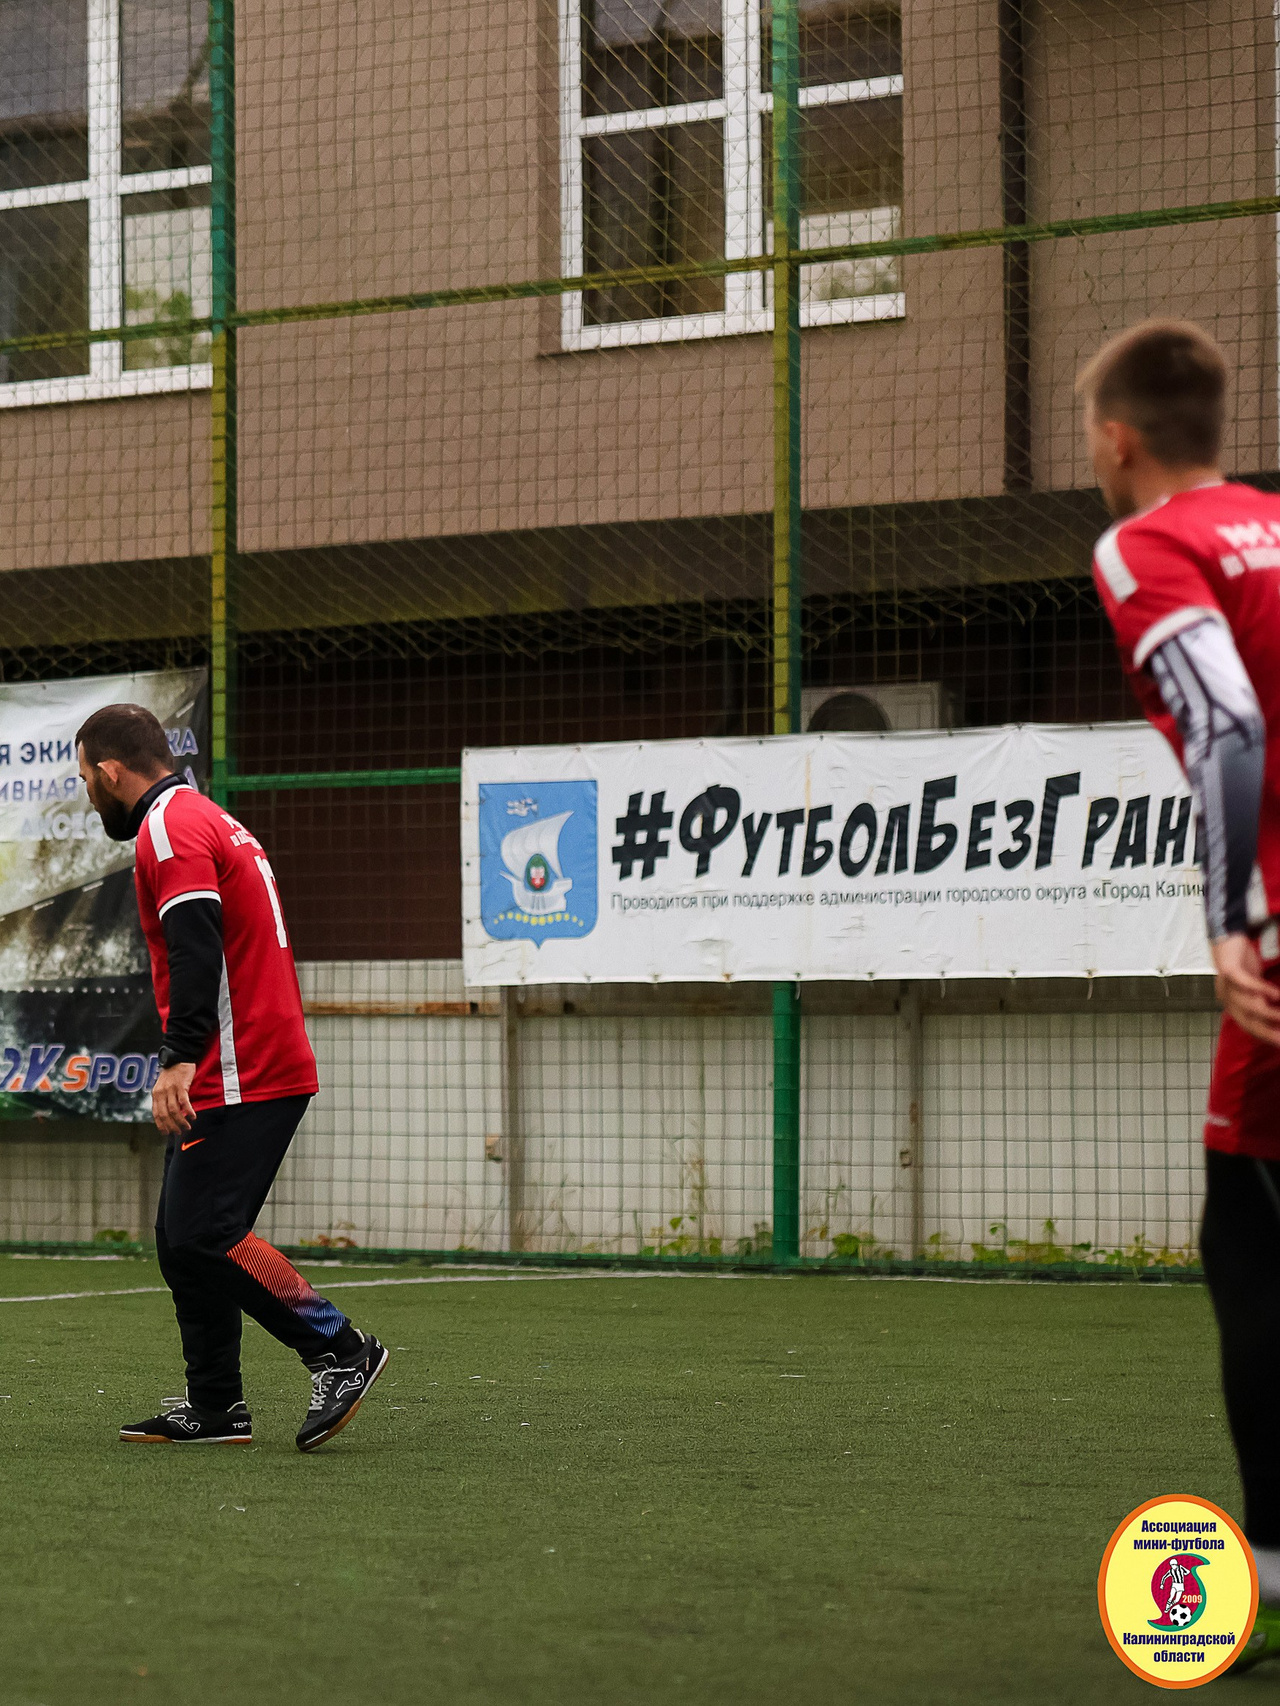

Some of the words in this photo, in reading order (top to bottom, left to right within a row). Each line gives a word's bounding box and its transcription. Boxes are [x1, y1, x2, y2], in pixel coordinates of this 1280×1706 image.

[610, 892, 698, 912] Проводится
[702, 894, 729, 912] при
[733, 891, 815, 912] поддержке
[819, 886, 942, 907] администрации
[946, 884, 1032, 905] городского
[1035, 884, 1087, 904] округа
[1093, 879, 1150, 903] «Город
